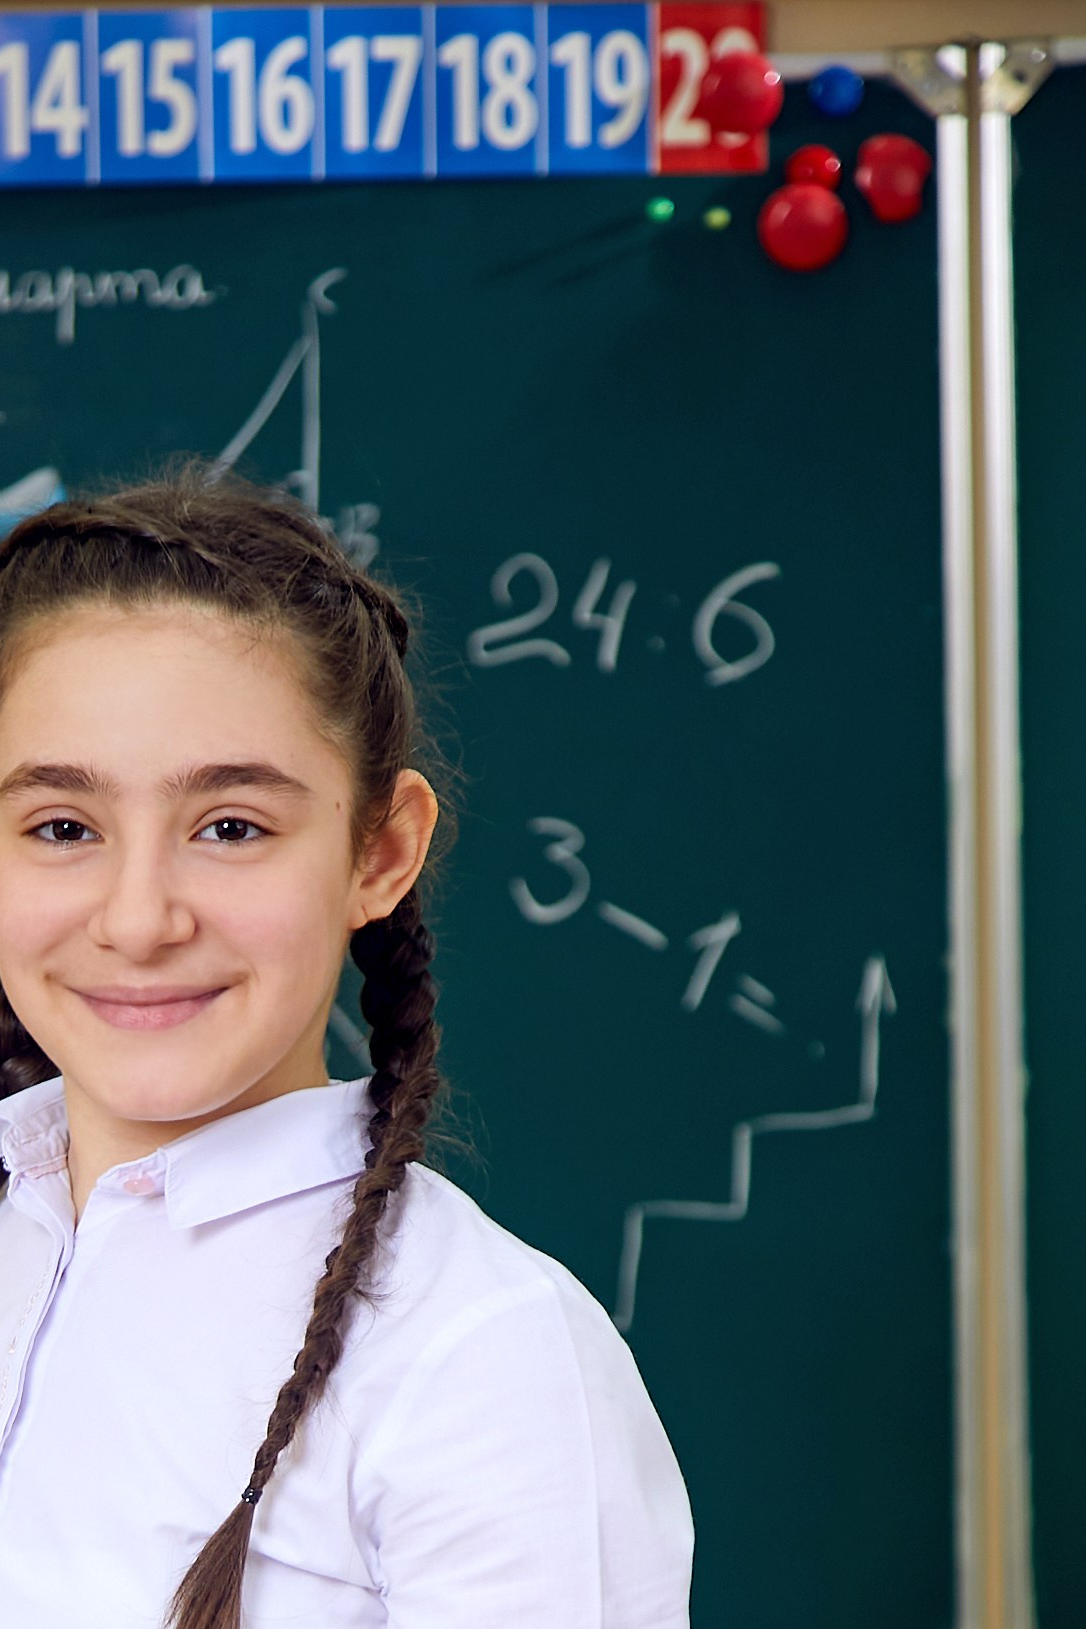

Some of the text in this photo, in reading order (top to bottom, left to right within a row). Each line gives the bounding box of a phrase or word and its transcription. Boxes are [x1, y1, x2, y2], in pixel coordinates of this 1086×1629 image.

[101, 38, 199, 157] 15
[214, 36, 316, 156] 16
[326, 35, 422, 153] 17
[438, 31, 540, 151] 18
[550, 30, 651, 149] 19
